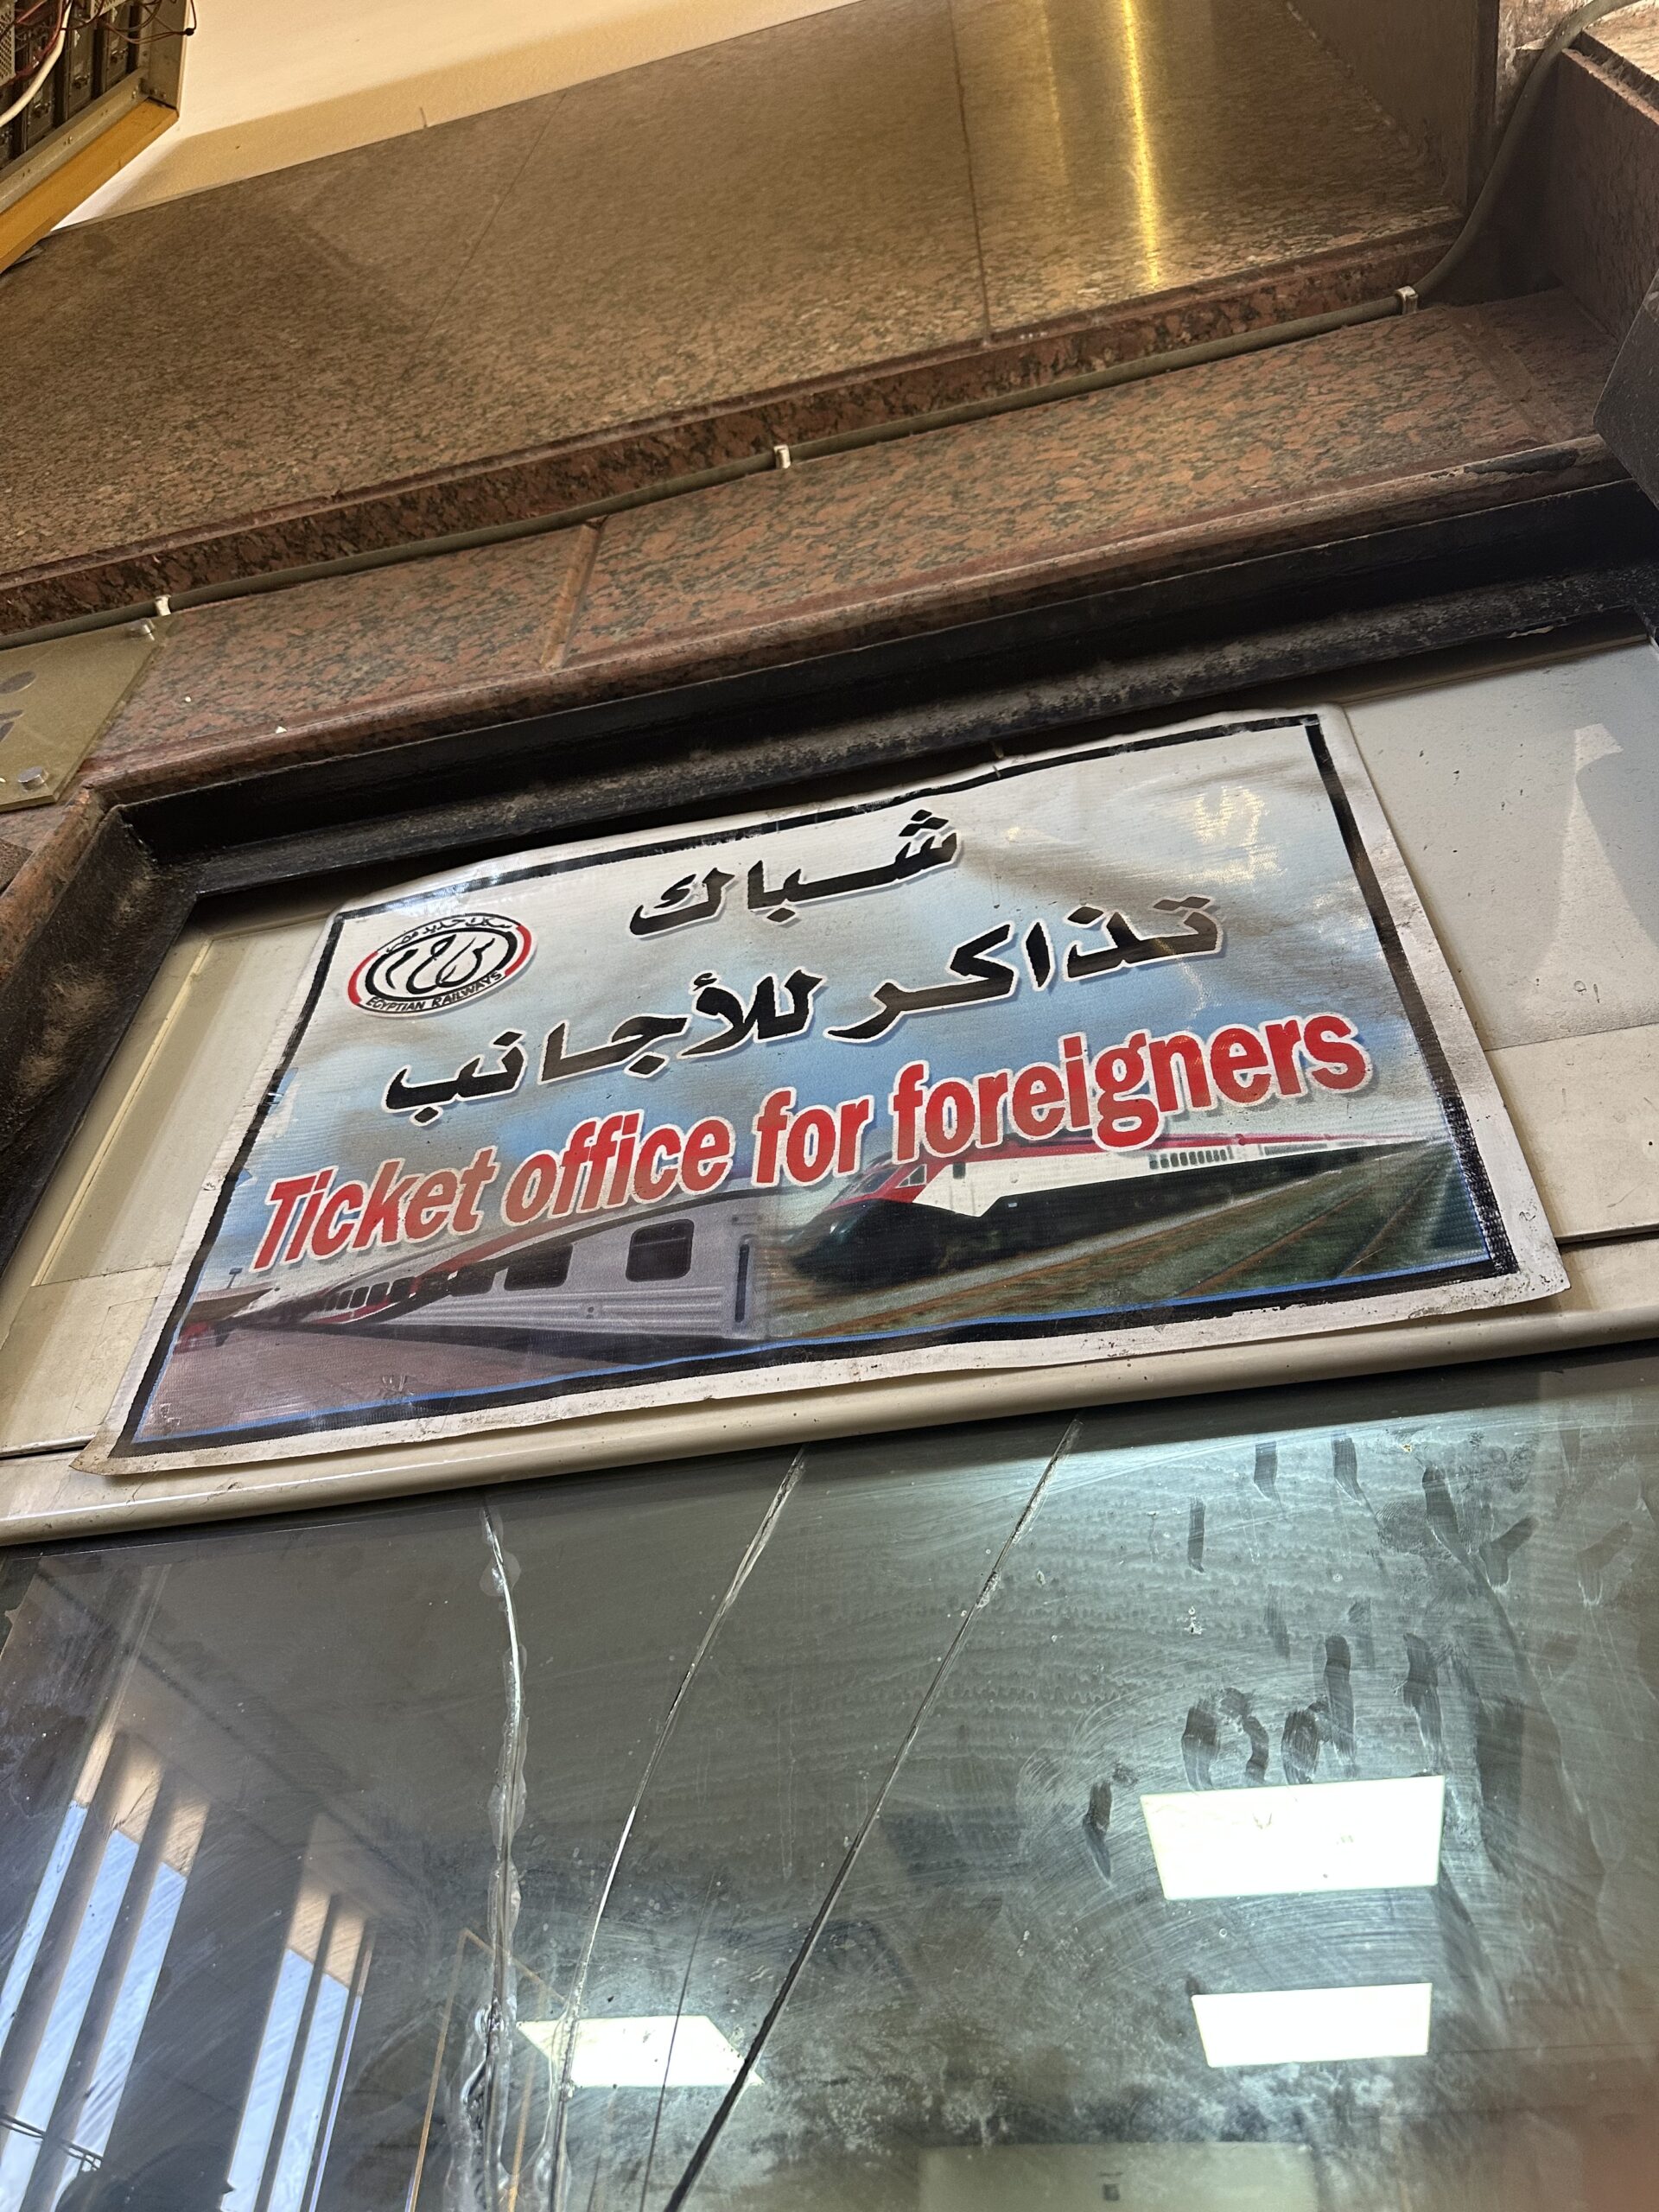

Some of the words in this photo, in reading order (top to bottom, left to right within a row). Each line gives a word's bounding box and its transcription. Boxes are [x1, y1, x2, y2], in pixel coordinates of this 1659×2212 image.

[629, 809, 958, 936] شباك
[365, 995, 425, 1013] EGYPTIAN
[431, 969, 503, 1009] RAILWAYS
[826, 895, 1219, 1039] تذاكر
[385, 969, 824, 1124] للأجانب
[252, 1148, 498, 1271] Ticket
[503, 1113, 731, 1226] office
[754, 1090, 870, 1184] for
[893, 1014, 1372, 1149] foreigners
